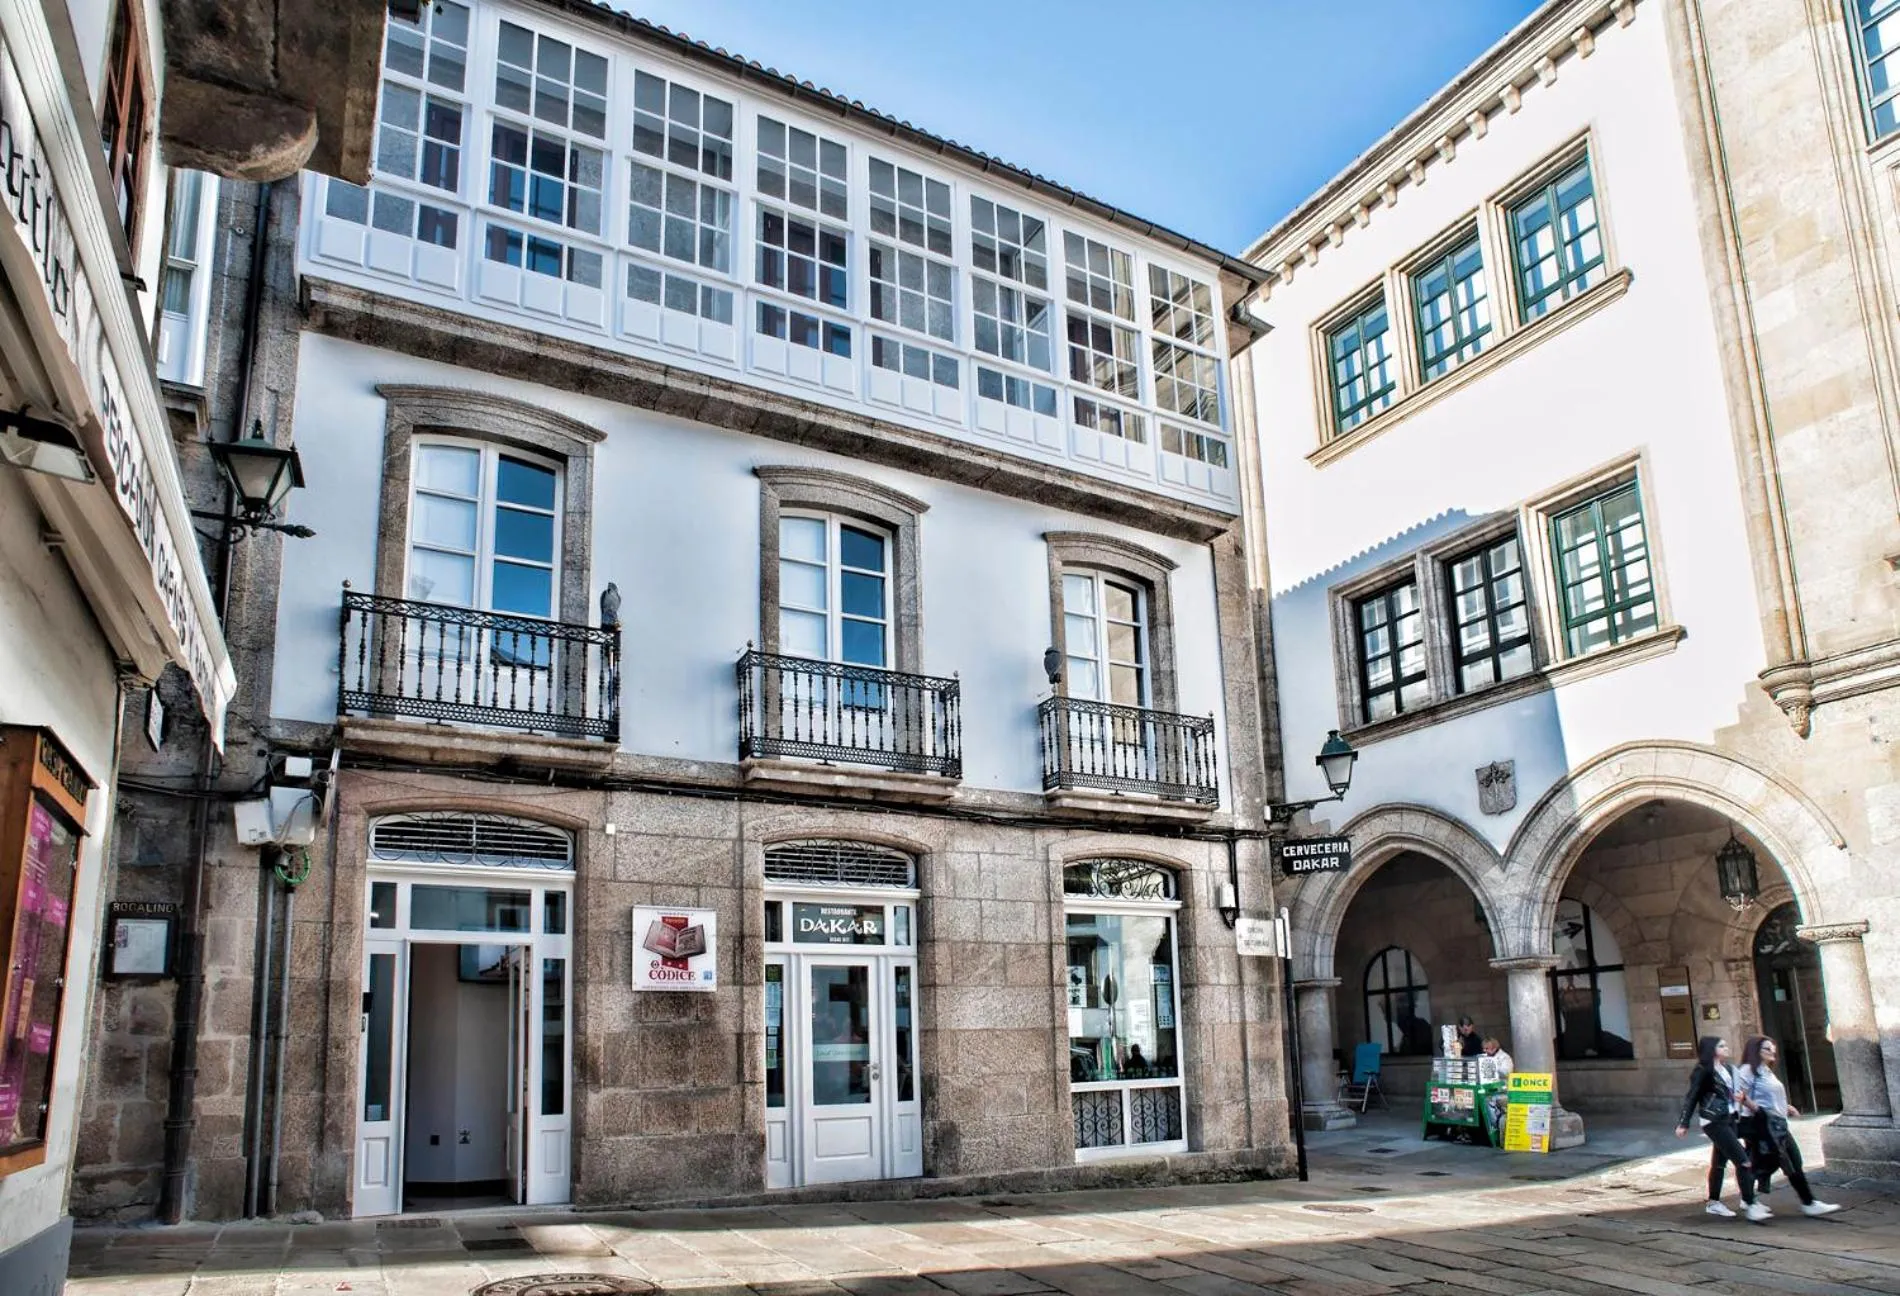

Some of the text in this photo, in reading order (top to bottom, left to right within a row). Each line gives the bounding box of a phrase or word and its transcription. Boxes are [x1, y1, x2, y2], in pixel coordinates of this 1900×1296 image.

[1282, 841, 1350, 857] CERVECERIA
[1293, 857, 1340, 871] DAKAR
[799, 917, 879, 935] DAKAR
[1522, 1078, 1549, 1088] ONCE
